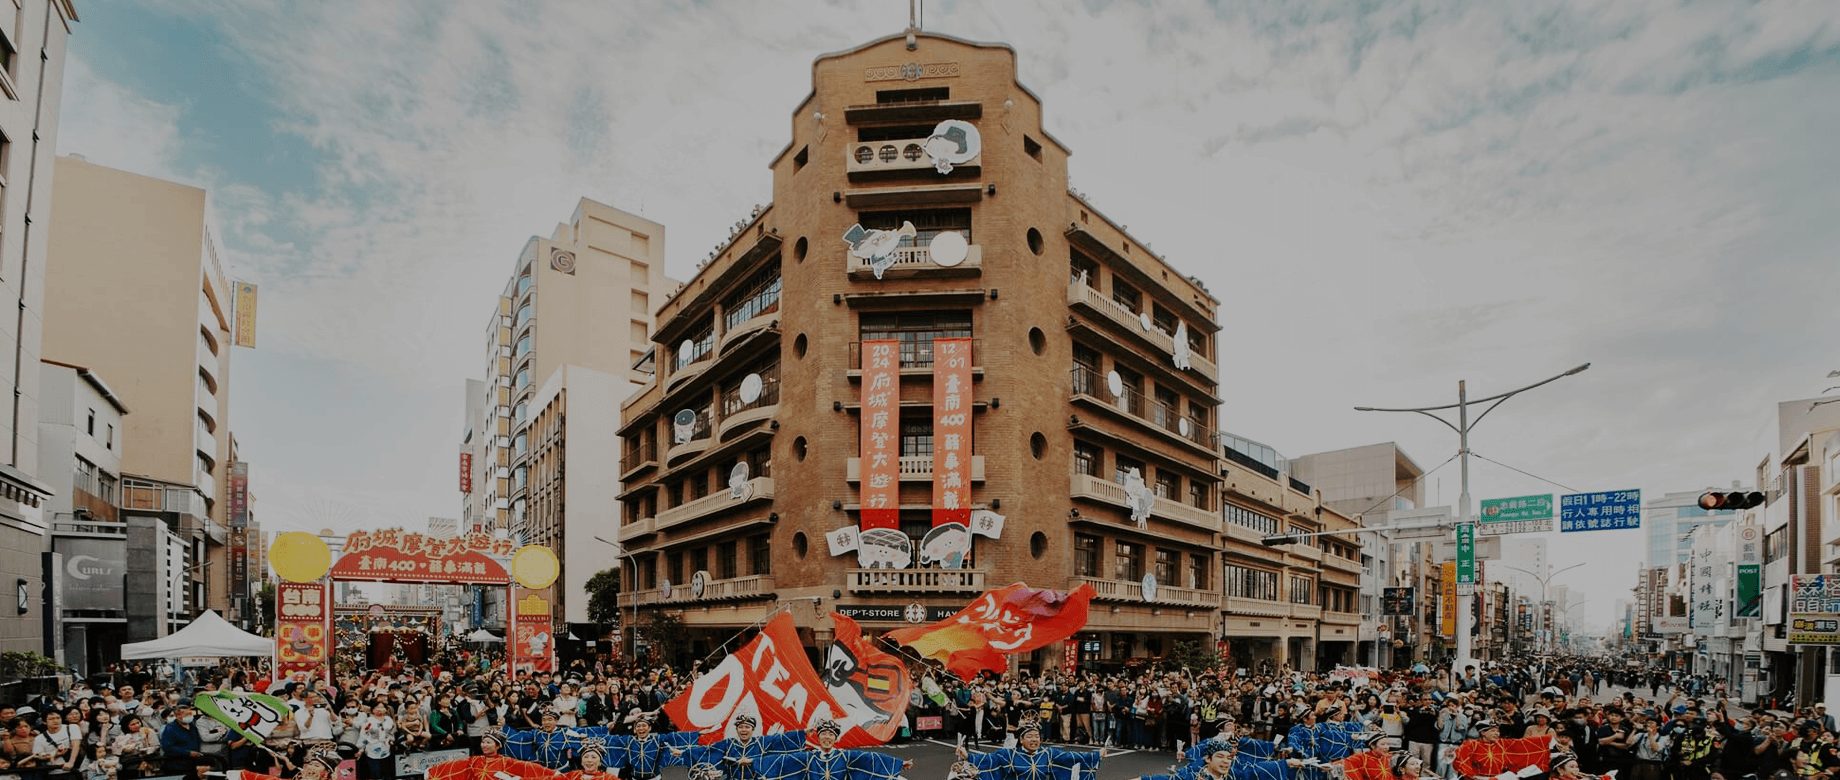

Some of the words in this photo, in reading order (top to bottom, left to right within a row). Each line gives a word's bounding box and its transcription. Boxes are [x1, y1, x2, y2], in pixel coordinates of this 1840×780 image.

[872, 344, 889, 357] 20
[872, 357, 890, 369] 24
[868, 371, 893, 509] 府城摩登大遊行
[342, 528, 515, 558] 府城摩登大遊行
[840, 609, 900, 617] DEP'T-STORE
